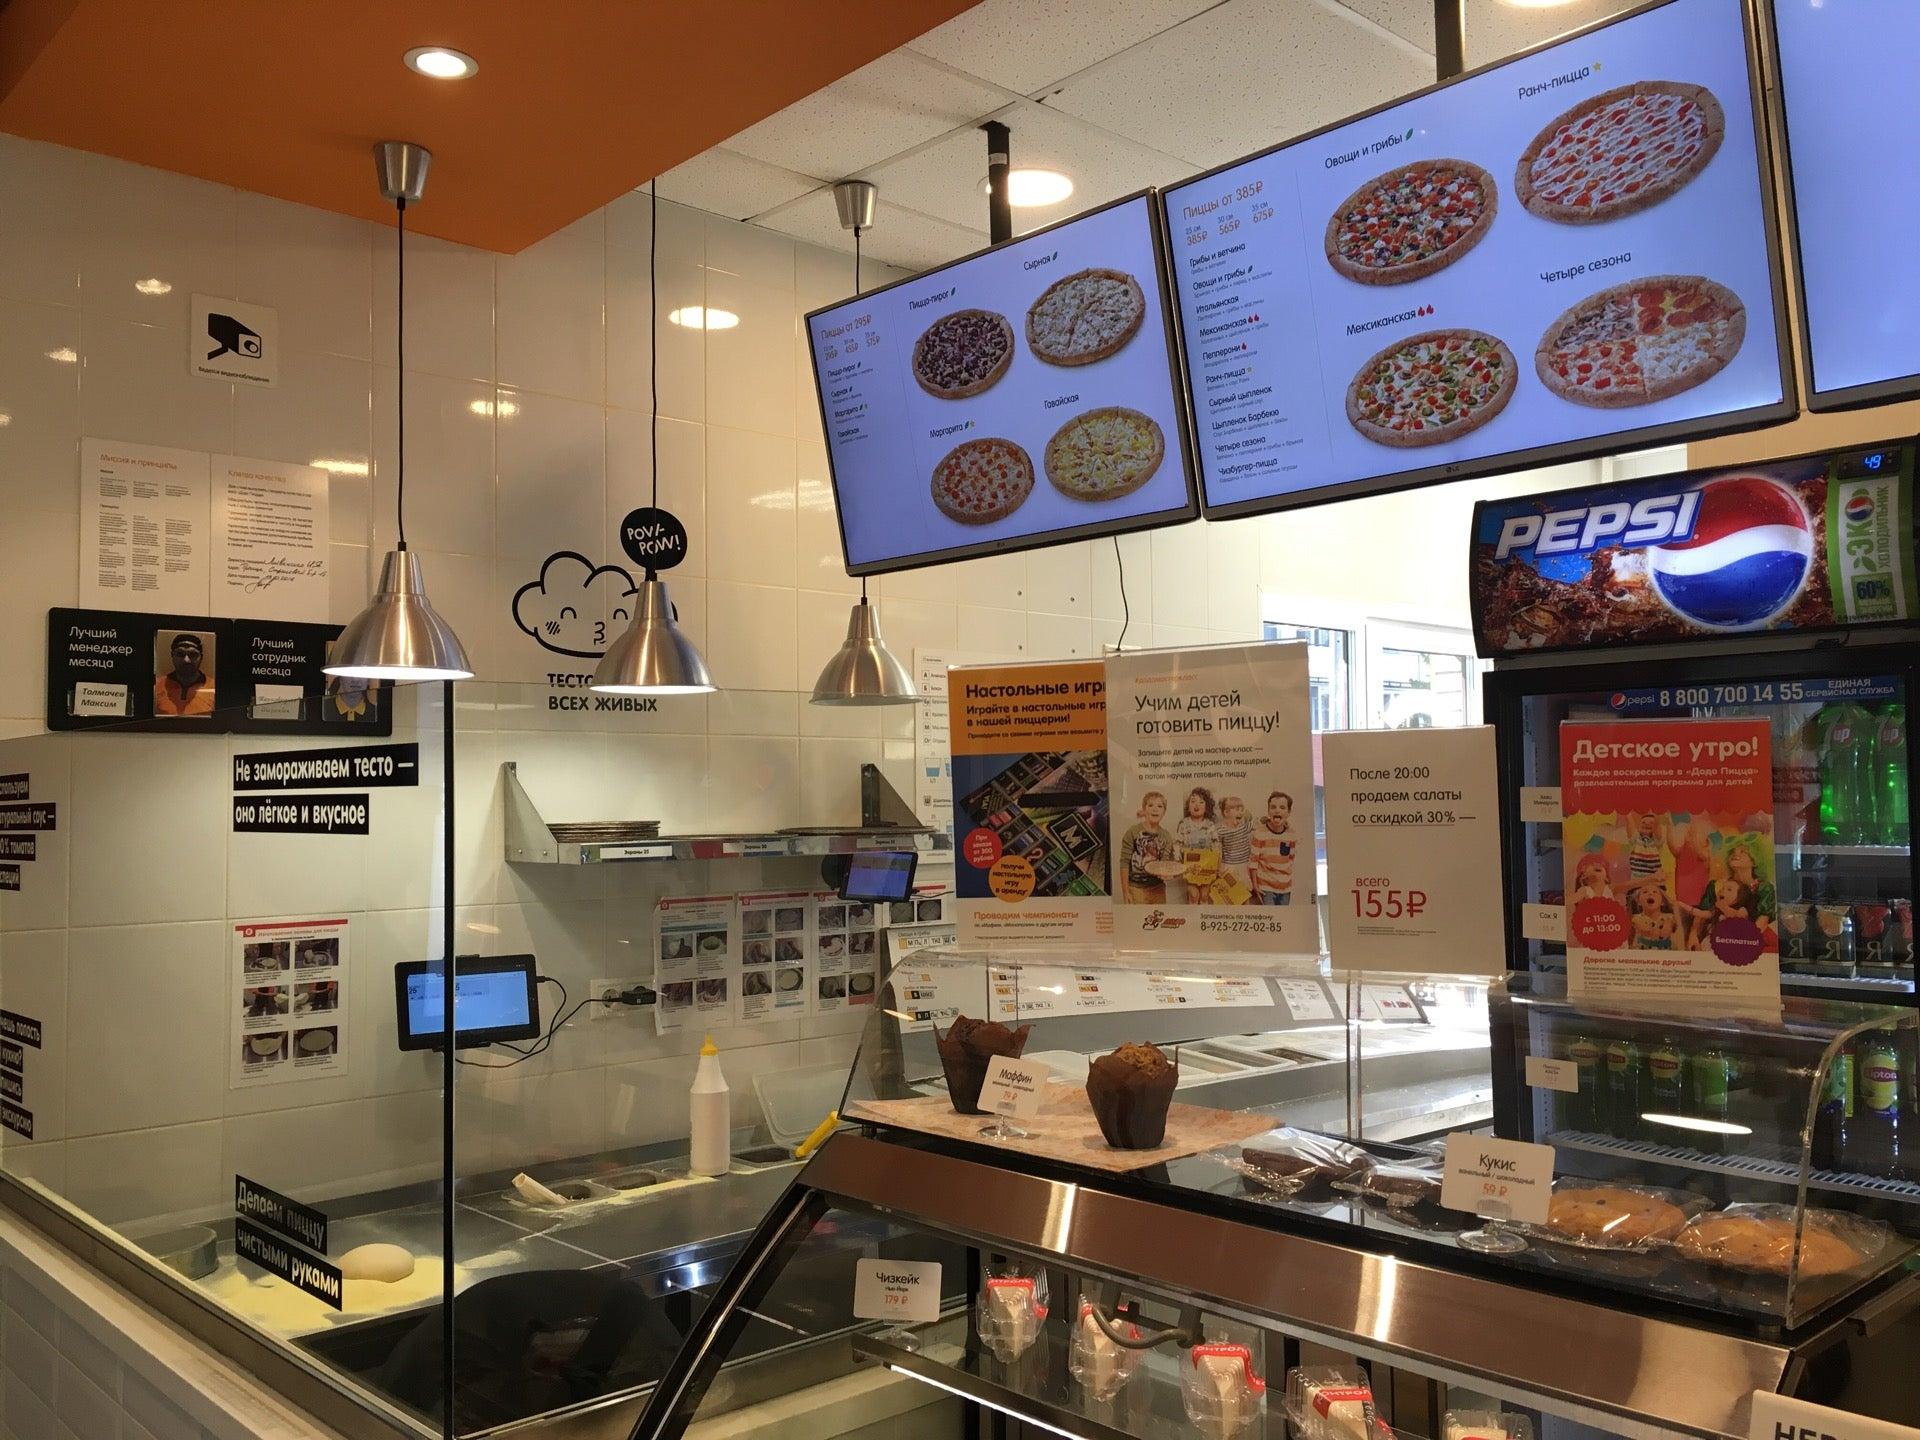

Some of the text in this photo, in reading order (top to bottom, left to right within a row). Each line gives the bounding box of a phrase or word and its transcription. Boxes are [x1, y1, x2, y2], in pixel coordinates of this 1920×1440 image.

[1518, 66, 1590, 100] Ранч-пицца
[1324, 132, 1403, 170] Овощи и грибы
[1183, 200, 1219, 220] Пиццы
[1222, 194, 1233, 206] от
[1023, 254, 1051, 271] Сырная
[1189, 243, 1246, 268] Грибы ветчина
[1540, 252, 1632, 284] Четыре сезона
[1192, 267, 1246, 291] Овощи грибы
[1196, 294, 1240, 314] Итальянская
[1200, 316, 1248, 337] Мексиканская
[1346, 308, 1416, 336] Мексиканская
[821, 324, 845, 340] Пиццы
[1202, 344, 1241, 360] Пепперони
[1206, 367, 1246, 384] Ранч-пицца
[1044, 394, 1080, 410] Гавайская
[1208, 386, 1273, 408] Сырный цыпленок
[1212, 408, 1280, 430] Цыпленок Барбекю
[929, 422, 964, 438] Маргарита
[1215, 436, 1266, 454] Четыре сезона
[1218, 458, 1278, 476] Чизбургер-пицца
[1864, 454, 1882, 469] 49
[1495, 494, 1701, 560] PEPSI
[1876, 486, 1890, 569] ХОЛОДИЛЬНИК
[639, 534, 681, 556] POW!
[1856, 580, 1890, 600] 60%
[69, 626, 117, 640] Лучший
[69, 643, 133, 656] менеджер
[252, 637, 294, 650] Лучший
[68, 658, 114, 670] месяца
[252, 653, 306, 664] сотрудник
[252, 667, 292, 677] месяца
[966, 683, 1069, 698] Настольные
[1828, 678, 1872, 688] ЕДИНАЯ
[1626, 682, 1804, 706] pepsi 8 800 700 14 55
[1805, 686, 1895, 698] СЕРВИСНАЯ СЛУЖБА
[80, 699, 117, 708] Максим
[548, 696, 658, 712] ВСЕХ ЖИВЫХ
[966, 704, 1010, 716] Играйте
[1021, 701, 1086, 713] настольные
[1134, 689, 1241, 712] Учим детей
[976, 715, 1012, 727] нашей
[1014, 713, 1070, 725] пиццерии!
[1136, 710, 1280, 734] готовить пиццу!
[1172, 747, 1194, 756] детей
[1205, 746, 1253, 755] мастер-класс
[1573, 736, 1759, 764] Детское утро!
[236, 755, 393, 786] Не замораживаем тесто
[1186, 758, 1222, 768] экскурсию
[1234, 757, 1272, 766] пиццерии,
[1167, 772, 1193, 780] научим
[1193, 771, 1224, 779] готовить
[1224, 770, 1247, 779] пиццу
[1350, 766, 1430, 780] После 20:00
[1573, 768, 1611, 779] Каждое
[1614, 768, 1674, 777] воскресенье
[1686, 766, 1718, 778] «Додо
[1720, 766, 1759, 777] Пицца»
[1574, 777, 1753, 788] развлекательная программа для детей
[1351, 789, 1462, 804] продаем салаты
[33, 810, 46, 828] соус
[235, 800, 366, 830] оно лёгкое и вкусное
[1352, 810, 1456, 826] со скидкой 30%
[10, 841, 34, 854] томатов
[1356, 876, 1390, 888] всего
[1351, 890, 1427, 919] 155₽
[974, 911, 1079, 920] Проводим чемпионаты
[1594, 914, 1616, 924] 11:00
[1200, 922, 1282, 932] 8-925-272-02-85
[1582, 924, 1621, 935] до 13:00
[1715, 936, 1760, 947] Бесплатно!
[1584, 956, 1692, 967] Дорогие маленькие друзья!
[999, 1068, 1033, 1084] Маффин
[1479, 1153, 1517, 1172] Кукис
[1483, 1182, 1496, 1196] 59
[238, 1181, 324, 1249] Делаем пиццу
[238, 1228, 339, 1300] чистыми руками
[876, 1272, 920, 1285] Чизкейк
[885, 1294, 899, 1304] 179
